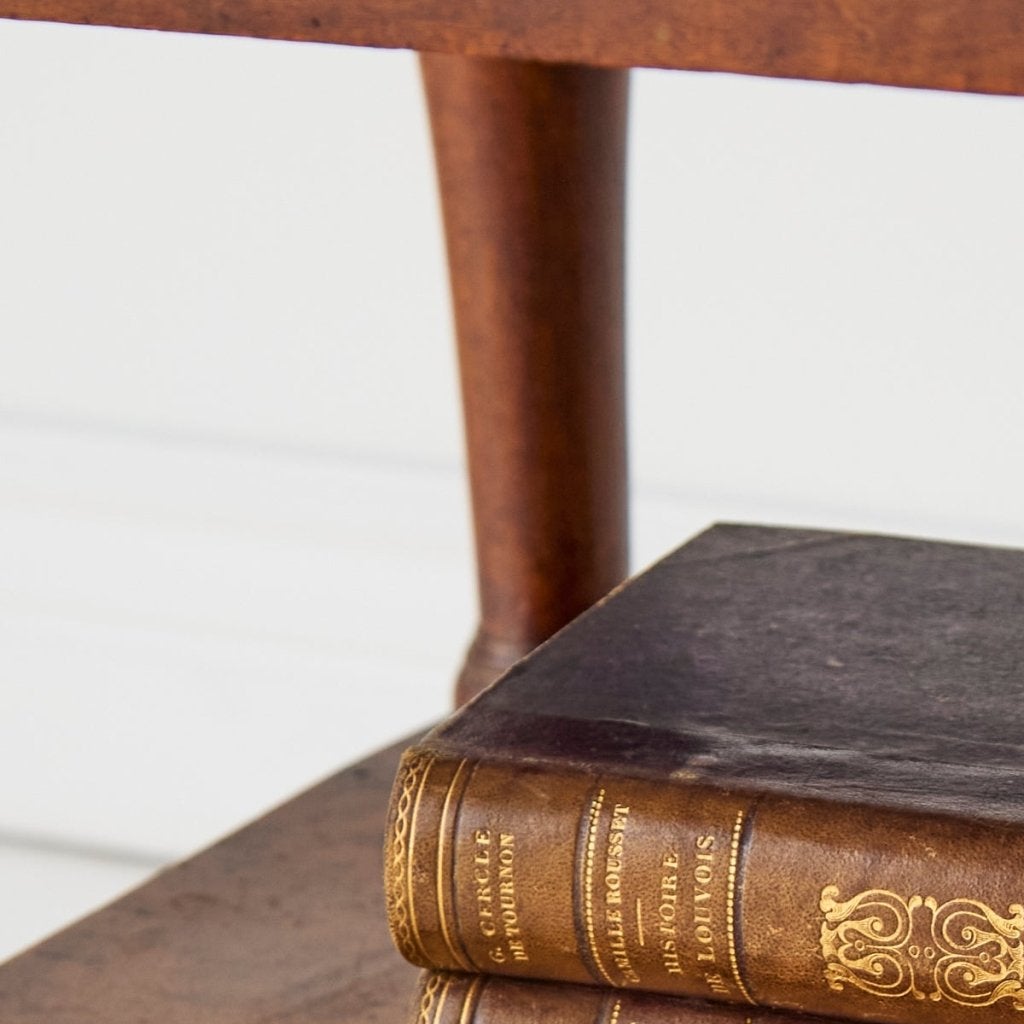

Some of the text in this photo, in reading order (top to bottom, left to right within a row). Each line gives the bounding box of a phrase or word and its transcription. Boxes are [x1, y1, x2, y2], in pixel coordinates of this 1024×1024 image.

[474, 829, 496, 937] CERCLE
[500, 833, 529, 961] DE TOURNON
[605, 803, 630, 905] ROUSSET
[659, 852, 685, 976] HISTOIRE
[694, 834, 729, 995] DE LOUVOIS
